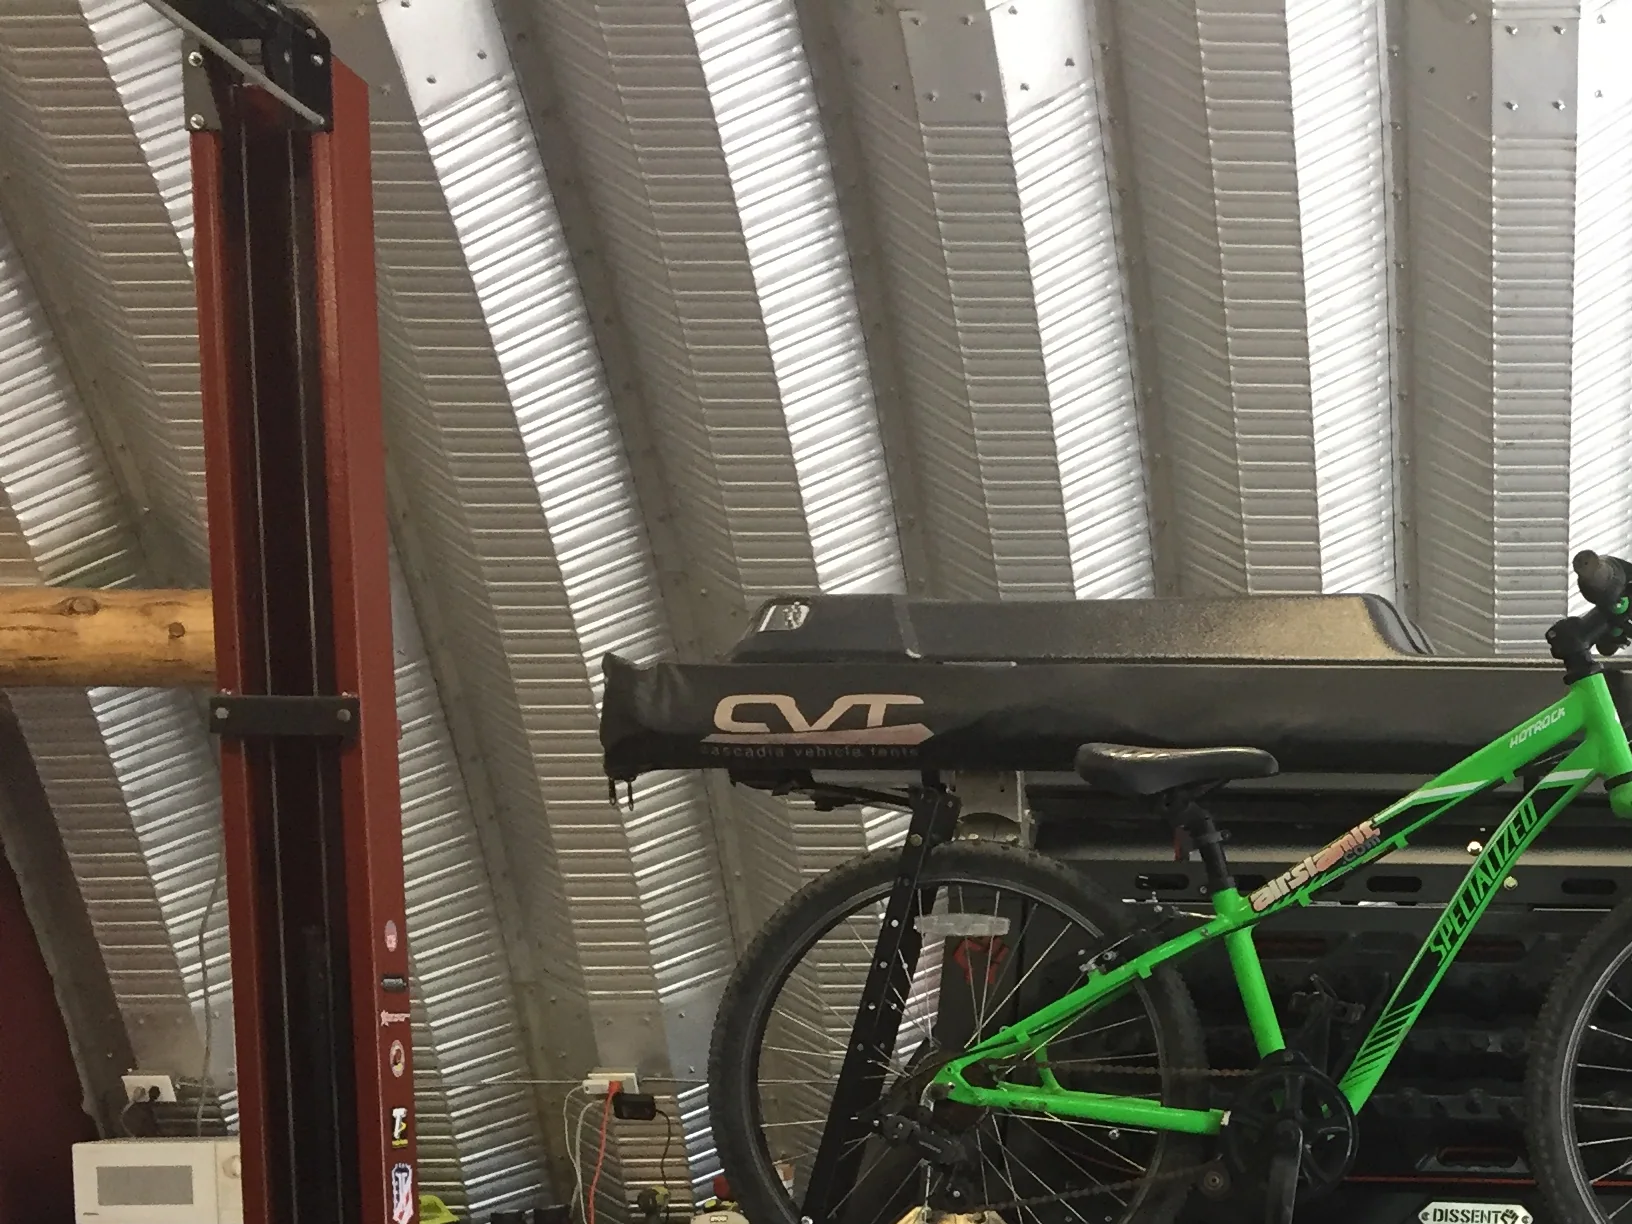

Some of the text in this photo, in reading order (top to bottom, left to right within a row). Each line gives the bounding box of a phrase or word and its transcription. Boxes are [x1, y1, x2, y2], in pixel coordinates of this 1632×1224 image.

[713, 694, 925, 732] CVT
[1509, 707, 1566, 749] HOTROCK
[701, 745, 919, 759] cascadia vehicle tents
[1429, 797, 1539, 967] SPECIALIZED
[1432, 1208, 1502, 1224] DISSENT
